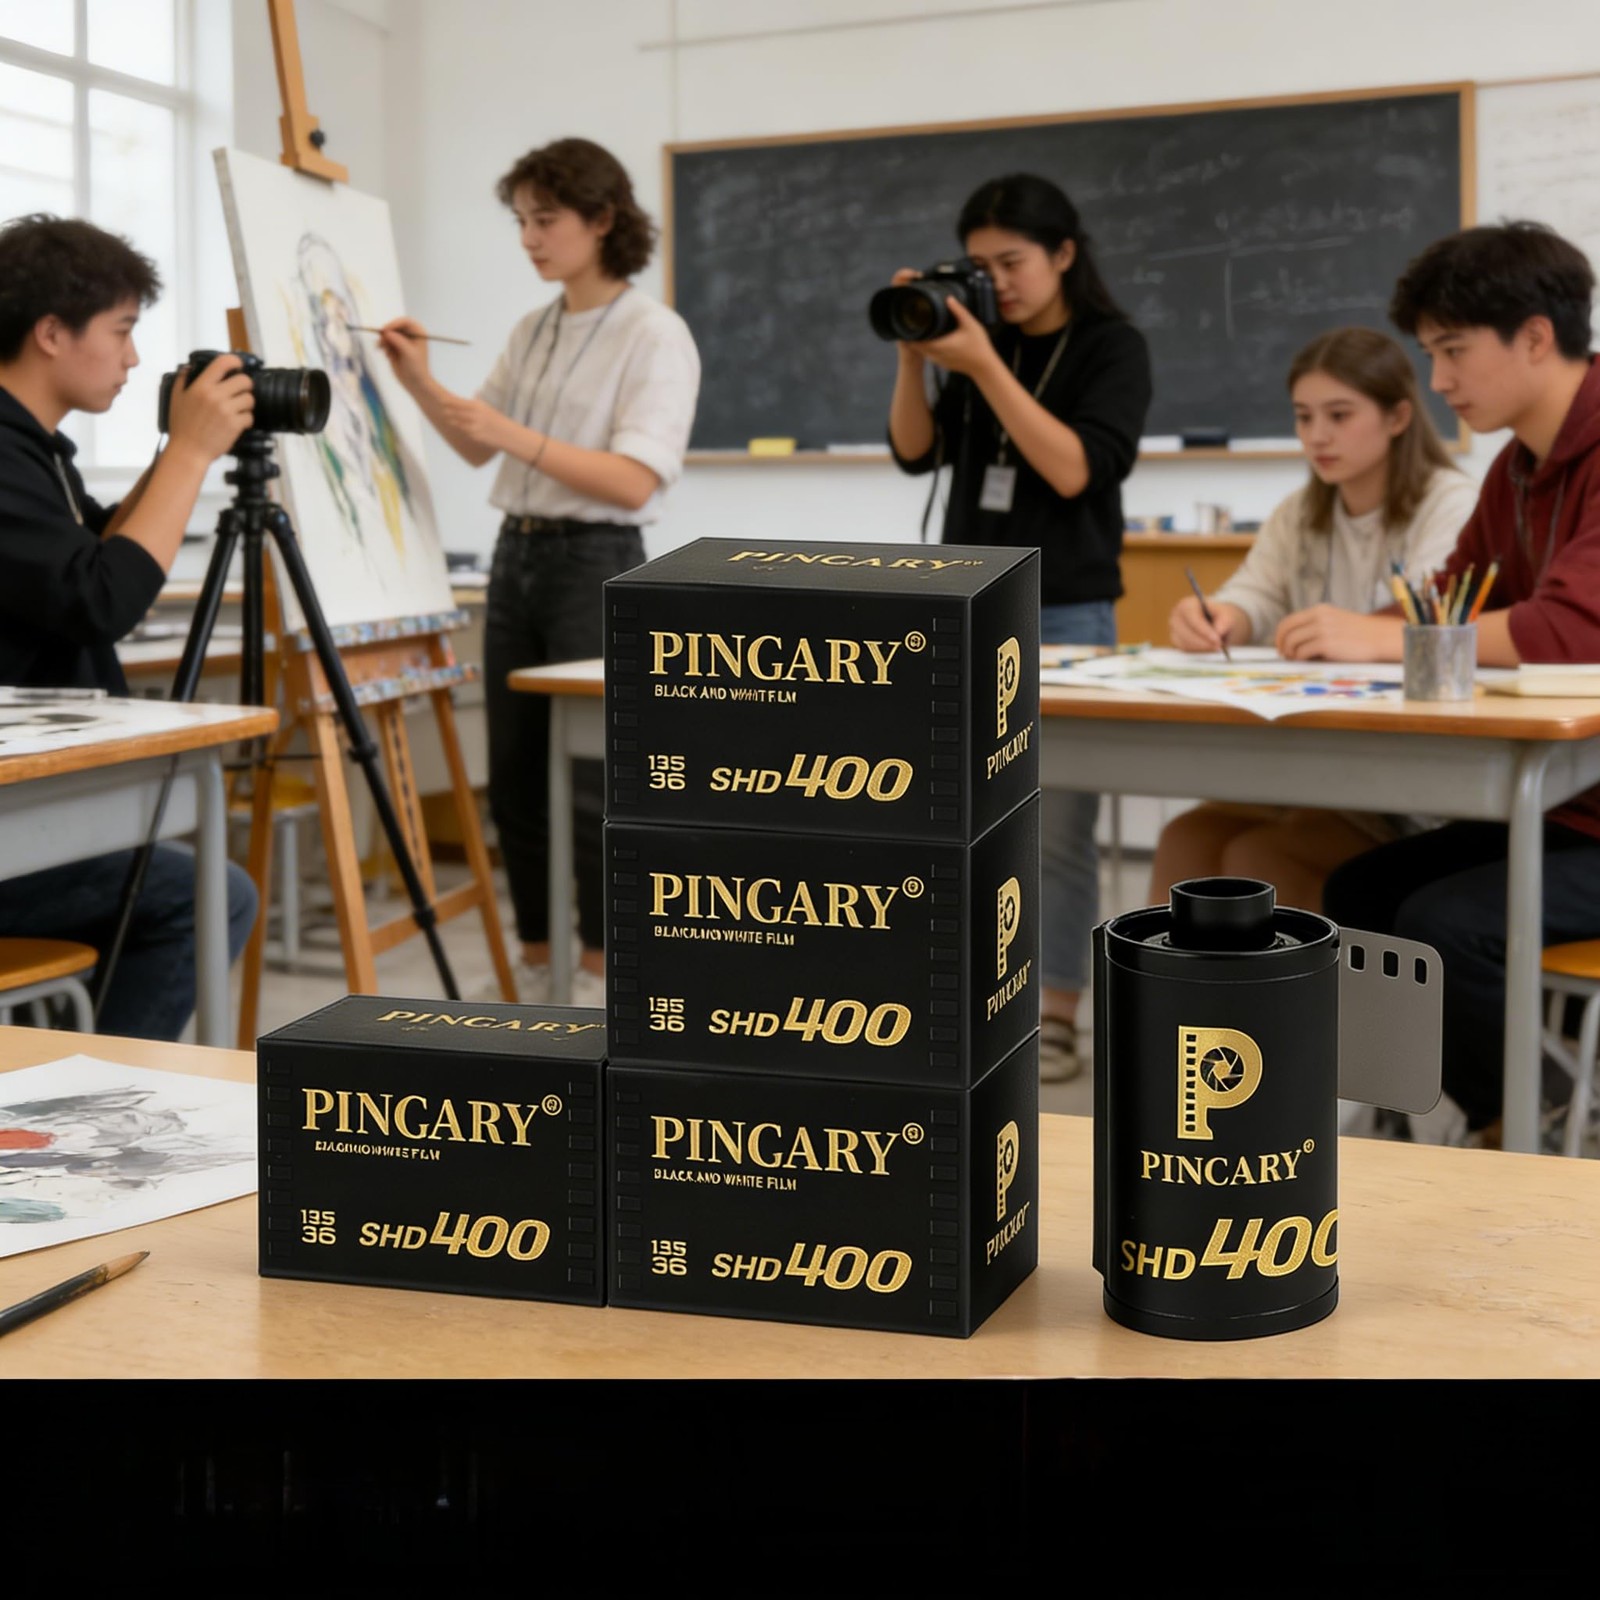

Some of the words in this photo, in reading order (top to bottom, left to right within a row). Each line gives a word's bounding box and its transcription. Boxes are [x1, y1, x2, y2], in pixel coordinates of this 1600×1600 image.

[650, 631, 902, 685] PINGARY
[655, 684, 697, 699] BLACK
[648, 755, 685, 771] 135
[649, 772, 686, 790] 36
[710, 766, 783, 793] SHD
[785, 753, 914, 802] 400
[649, 872, 900, 930] PINGARY
[649, 997, 685, 1013] 135
[650, 1014, 685, 1033] 36
[709, 1009, 780, 1037] SHD
[782, 997, 912, 1047] 400
[300, 1209, 336, 1226] 135
[301, 1226, 337, 1245] 36
[359, 1222, 428, 1250] SHD
[430, 1211, 551, 1262] 400
[651, 1239, 687, 1257] 135
[652, 1256, 688, 1275] 36
[711, 1253, 783, 1281] SHD
[784, 1242, 913, 1294] 400
[1121, 1240, 1197, 1280] SHD
